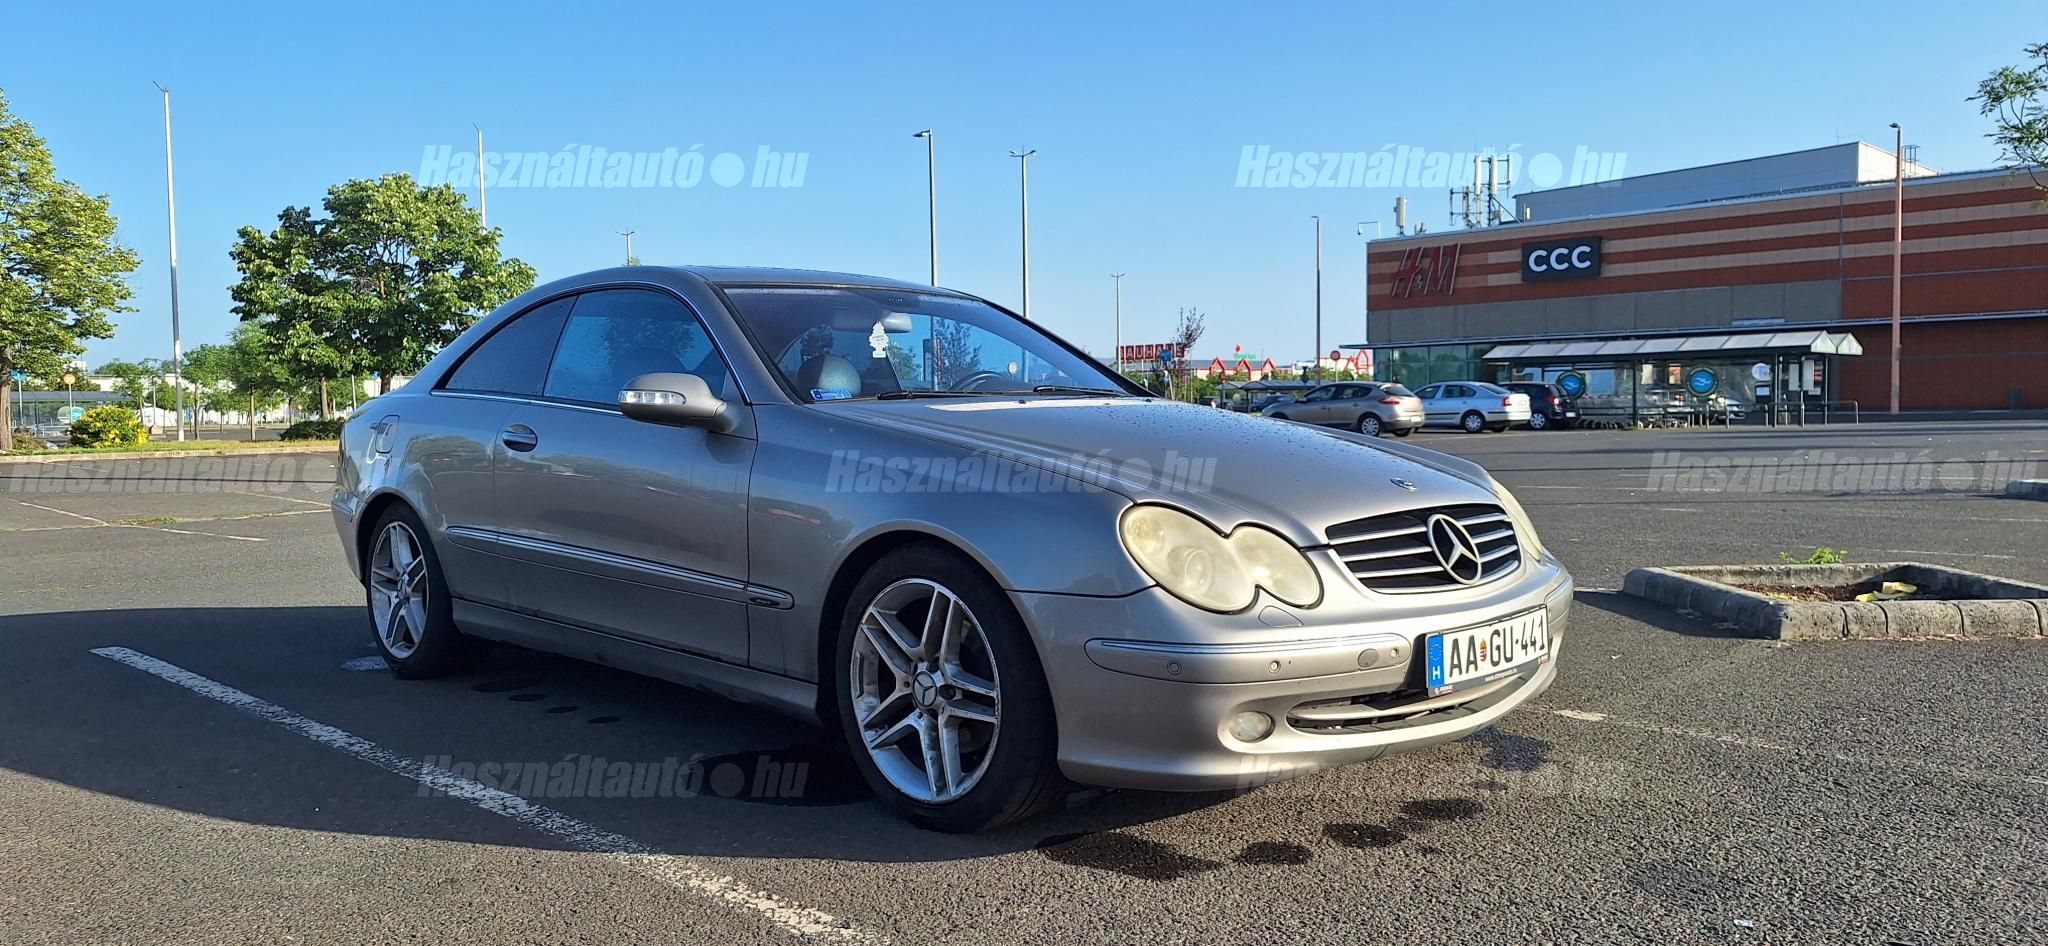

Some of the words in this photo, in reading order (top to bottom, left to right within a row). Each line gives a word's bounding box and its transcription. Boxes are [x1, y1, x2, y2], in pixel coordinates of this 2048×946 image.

[1391, 243, 1461, 298] H&M
[1528, 245, 1592, 272] CCC
[1490, 614, 1545, 667] GU-441
[1432, 665, 1441, 681] H
